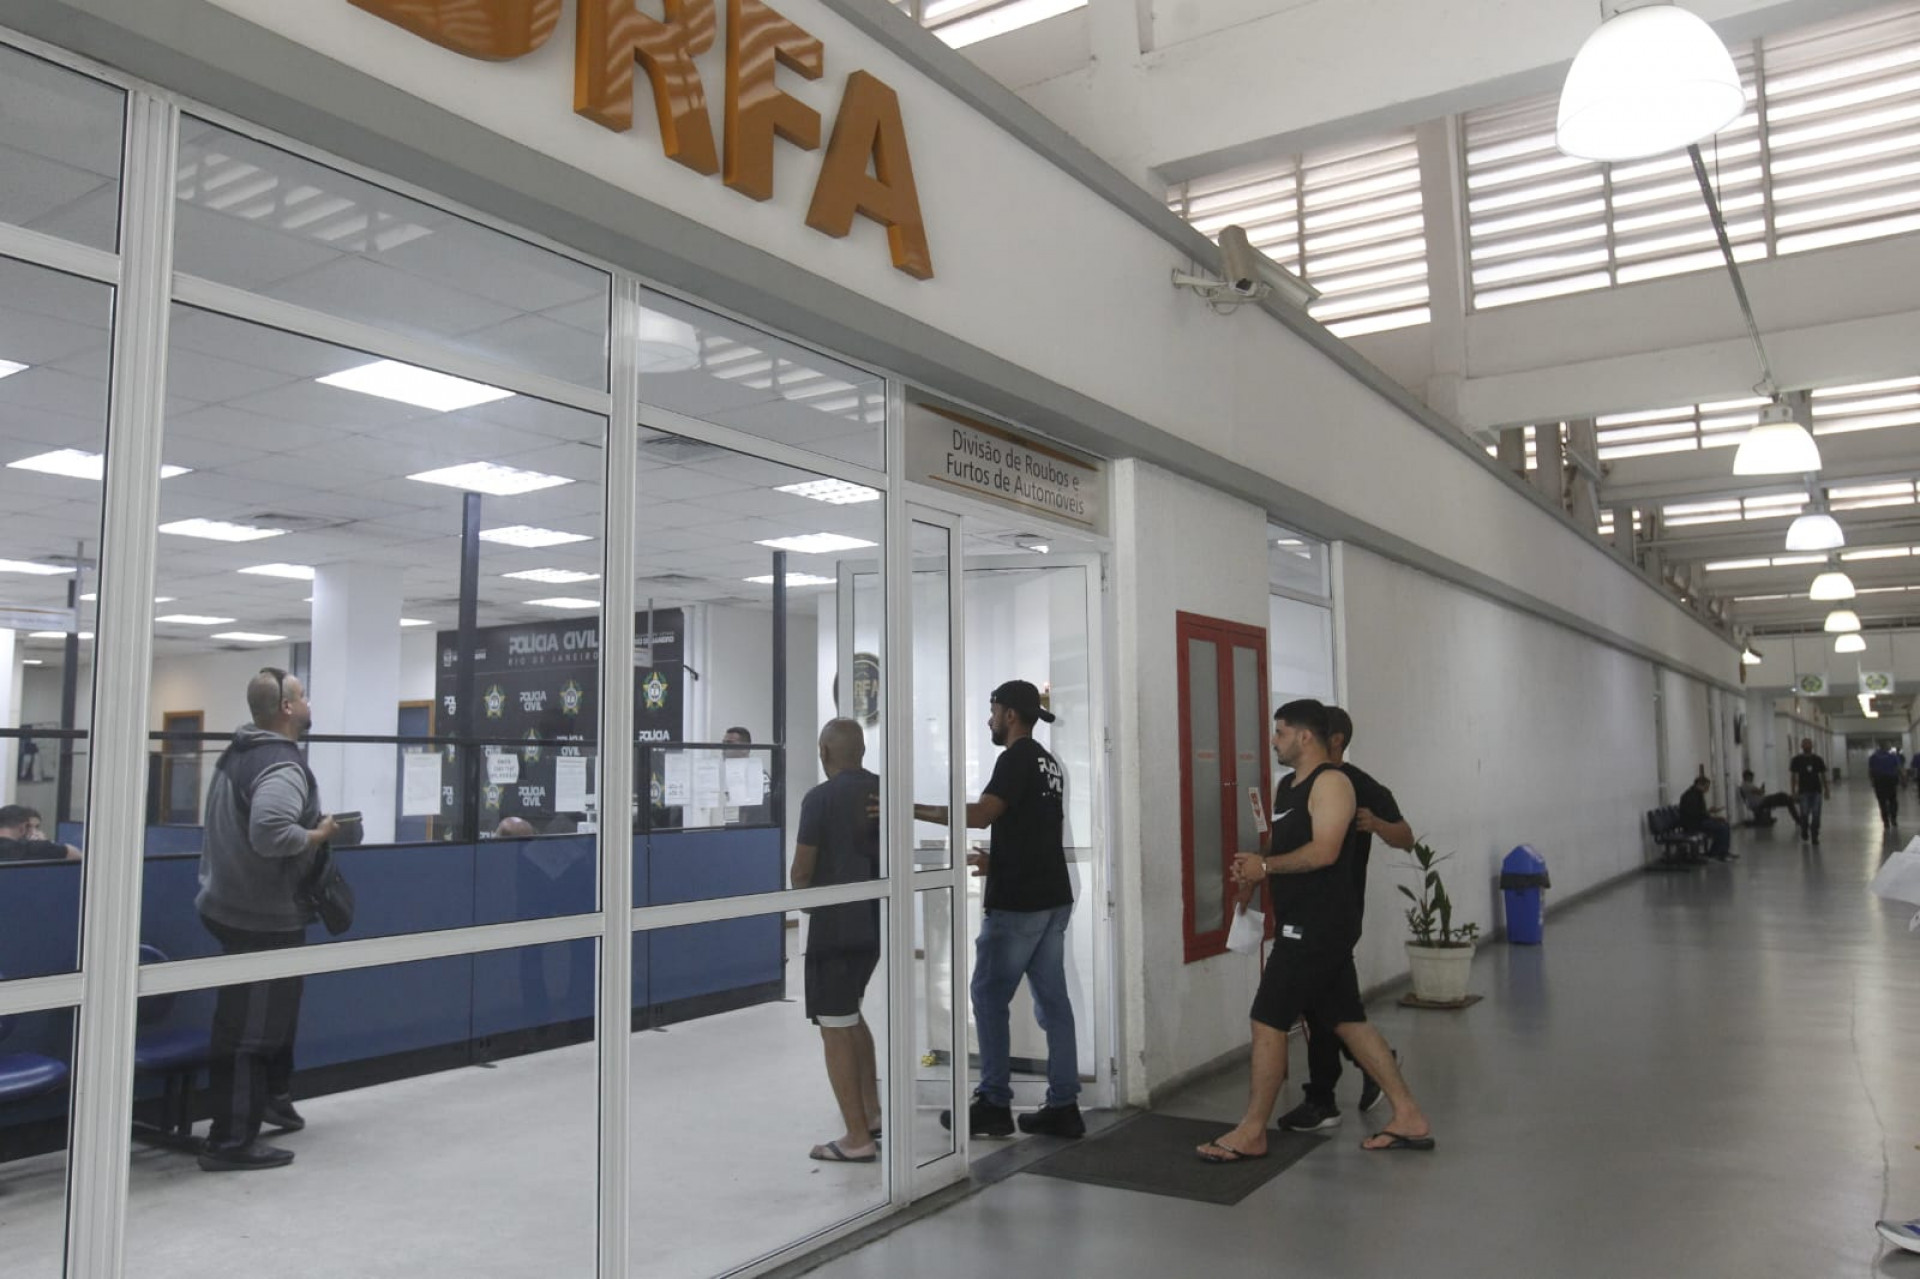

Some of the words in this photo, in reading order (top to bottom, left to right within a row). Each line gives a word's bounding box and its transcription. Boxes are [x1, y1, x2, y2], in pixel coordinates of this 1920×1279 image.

[952, 429, 1001, 464] Divisão
[1006, 448, 1021, 471] de
[1025, 454, 1069, 487] Roubos
[1072, 476, 1080, 492] e
[946, 452, 990, 486] Furtos
[994, 468, 1010, 492] de
[1013, 475, 1084, 515] Automóveis
[563, 629, 600, 651] CIVIL
[508, 657, 526, 667] RIO
[552, 651, 600, 663] JANEIRO
[854, 679, 879, 698] RFA
[523, 702, 544, 712] CIVIL
[522, 796, 542, 807] CIVIL
